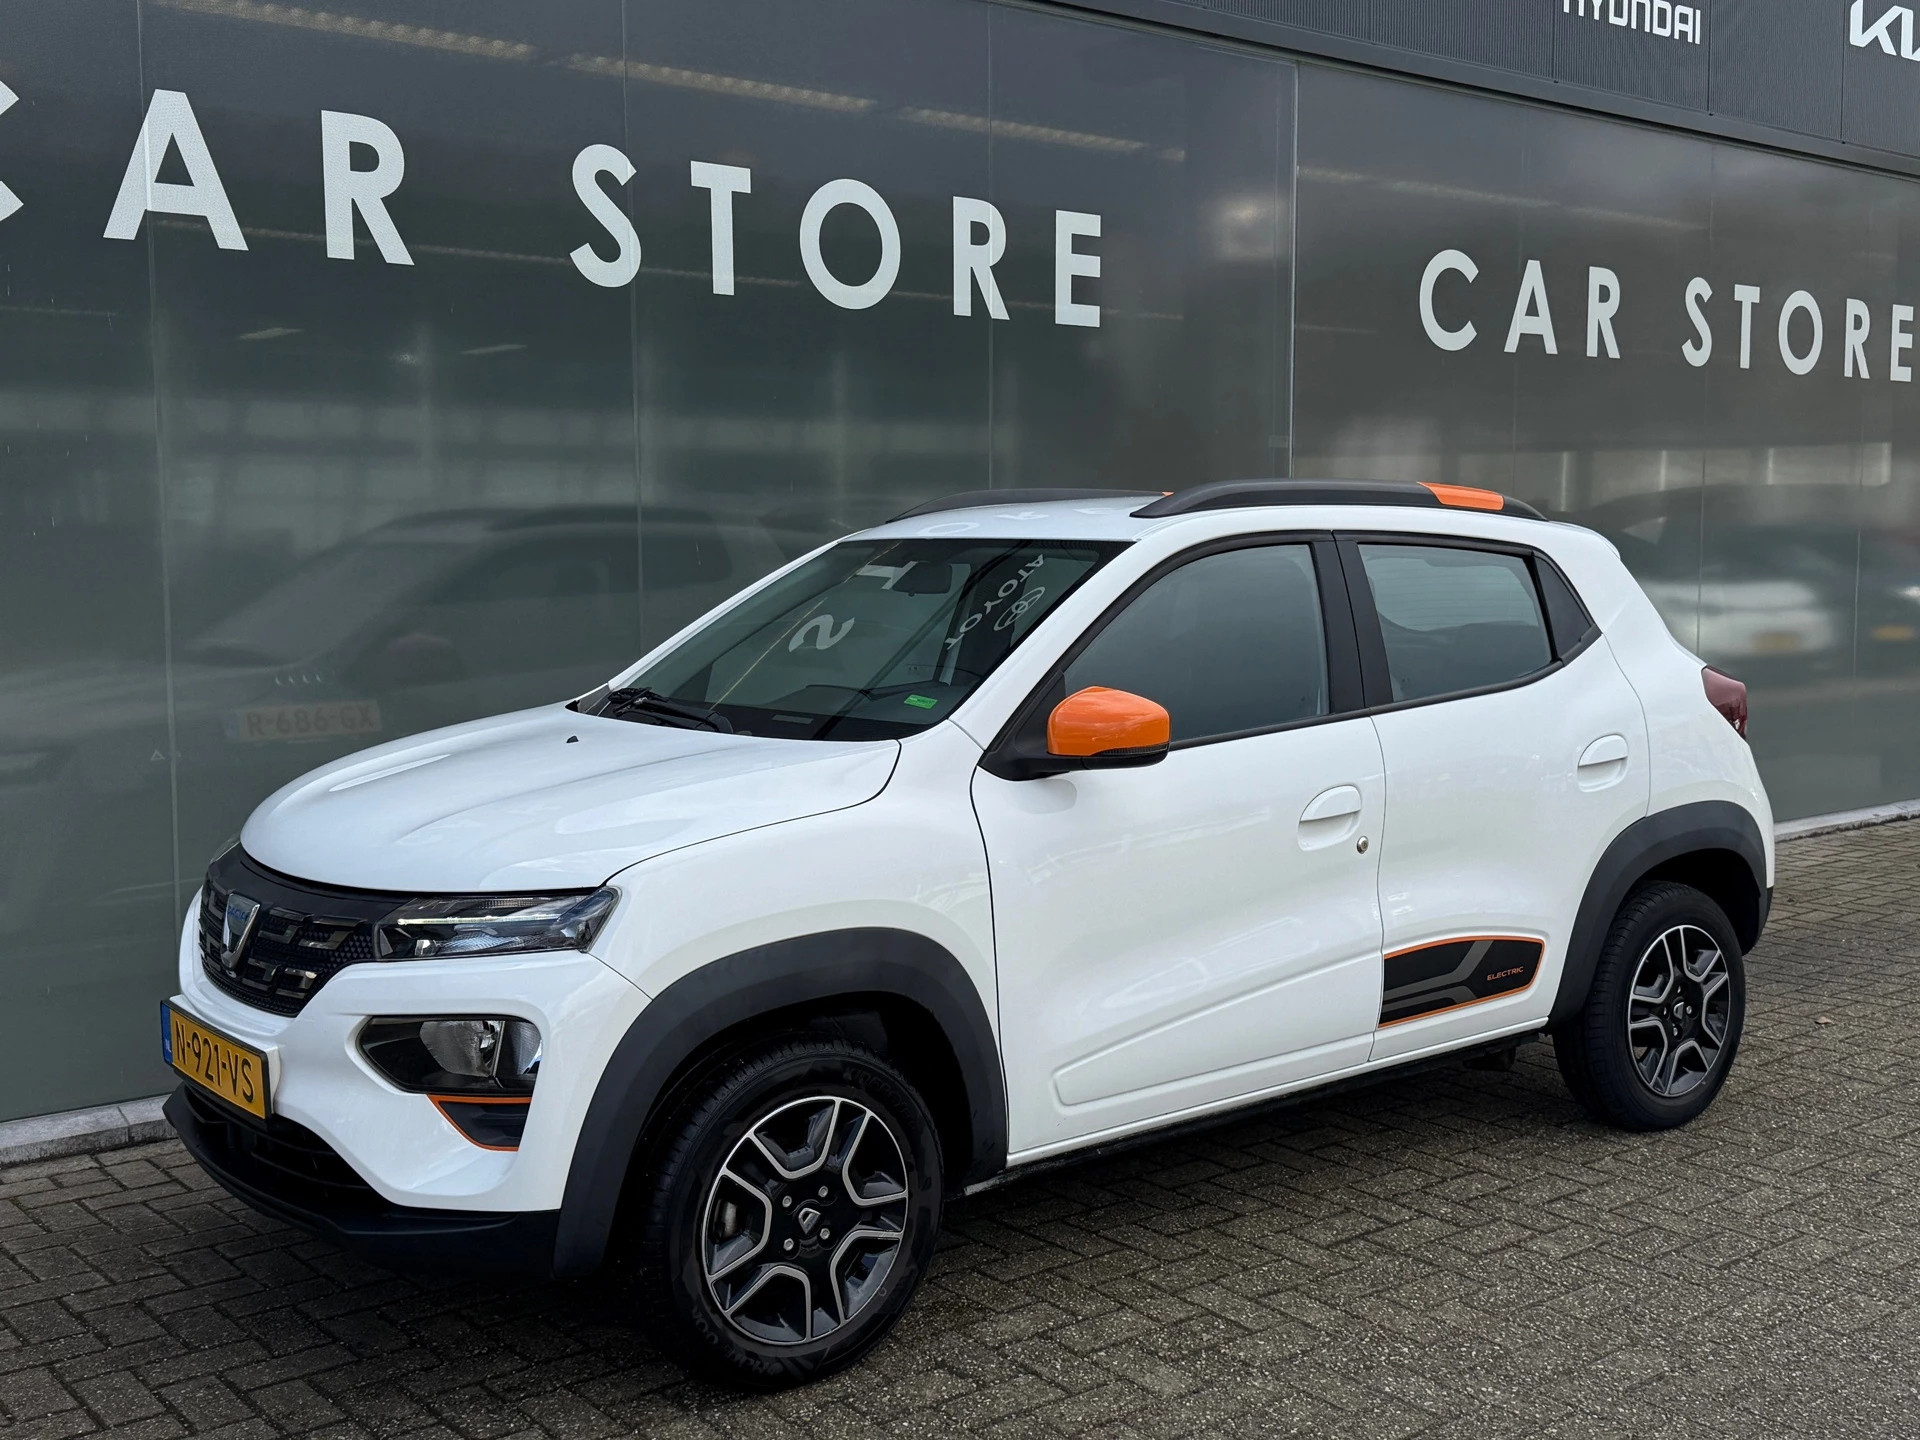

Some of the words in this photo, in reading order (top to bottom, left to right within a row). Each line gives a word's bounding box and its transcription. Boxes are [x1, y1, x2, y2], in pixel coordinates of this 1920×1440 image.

[1844, 0, 1920, 62] KI
[0, 80, 415, 267] AR
[569, 143, 1101, 328] STORE
[1418, 248, 1621, 360] CAR
[1681, 276, 1914, 383] STORE
[246, 705, 376, 738] R-686-GX
[1486, 966, 1524, 981] ELECTRIC
[175, 1018, 254, 1103] N-921-VS
